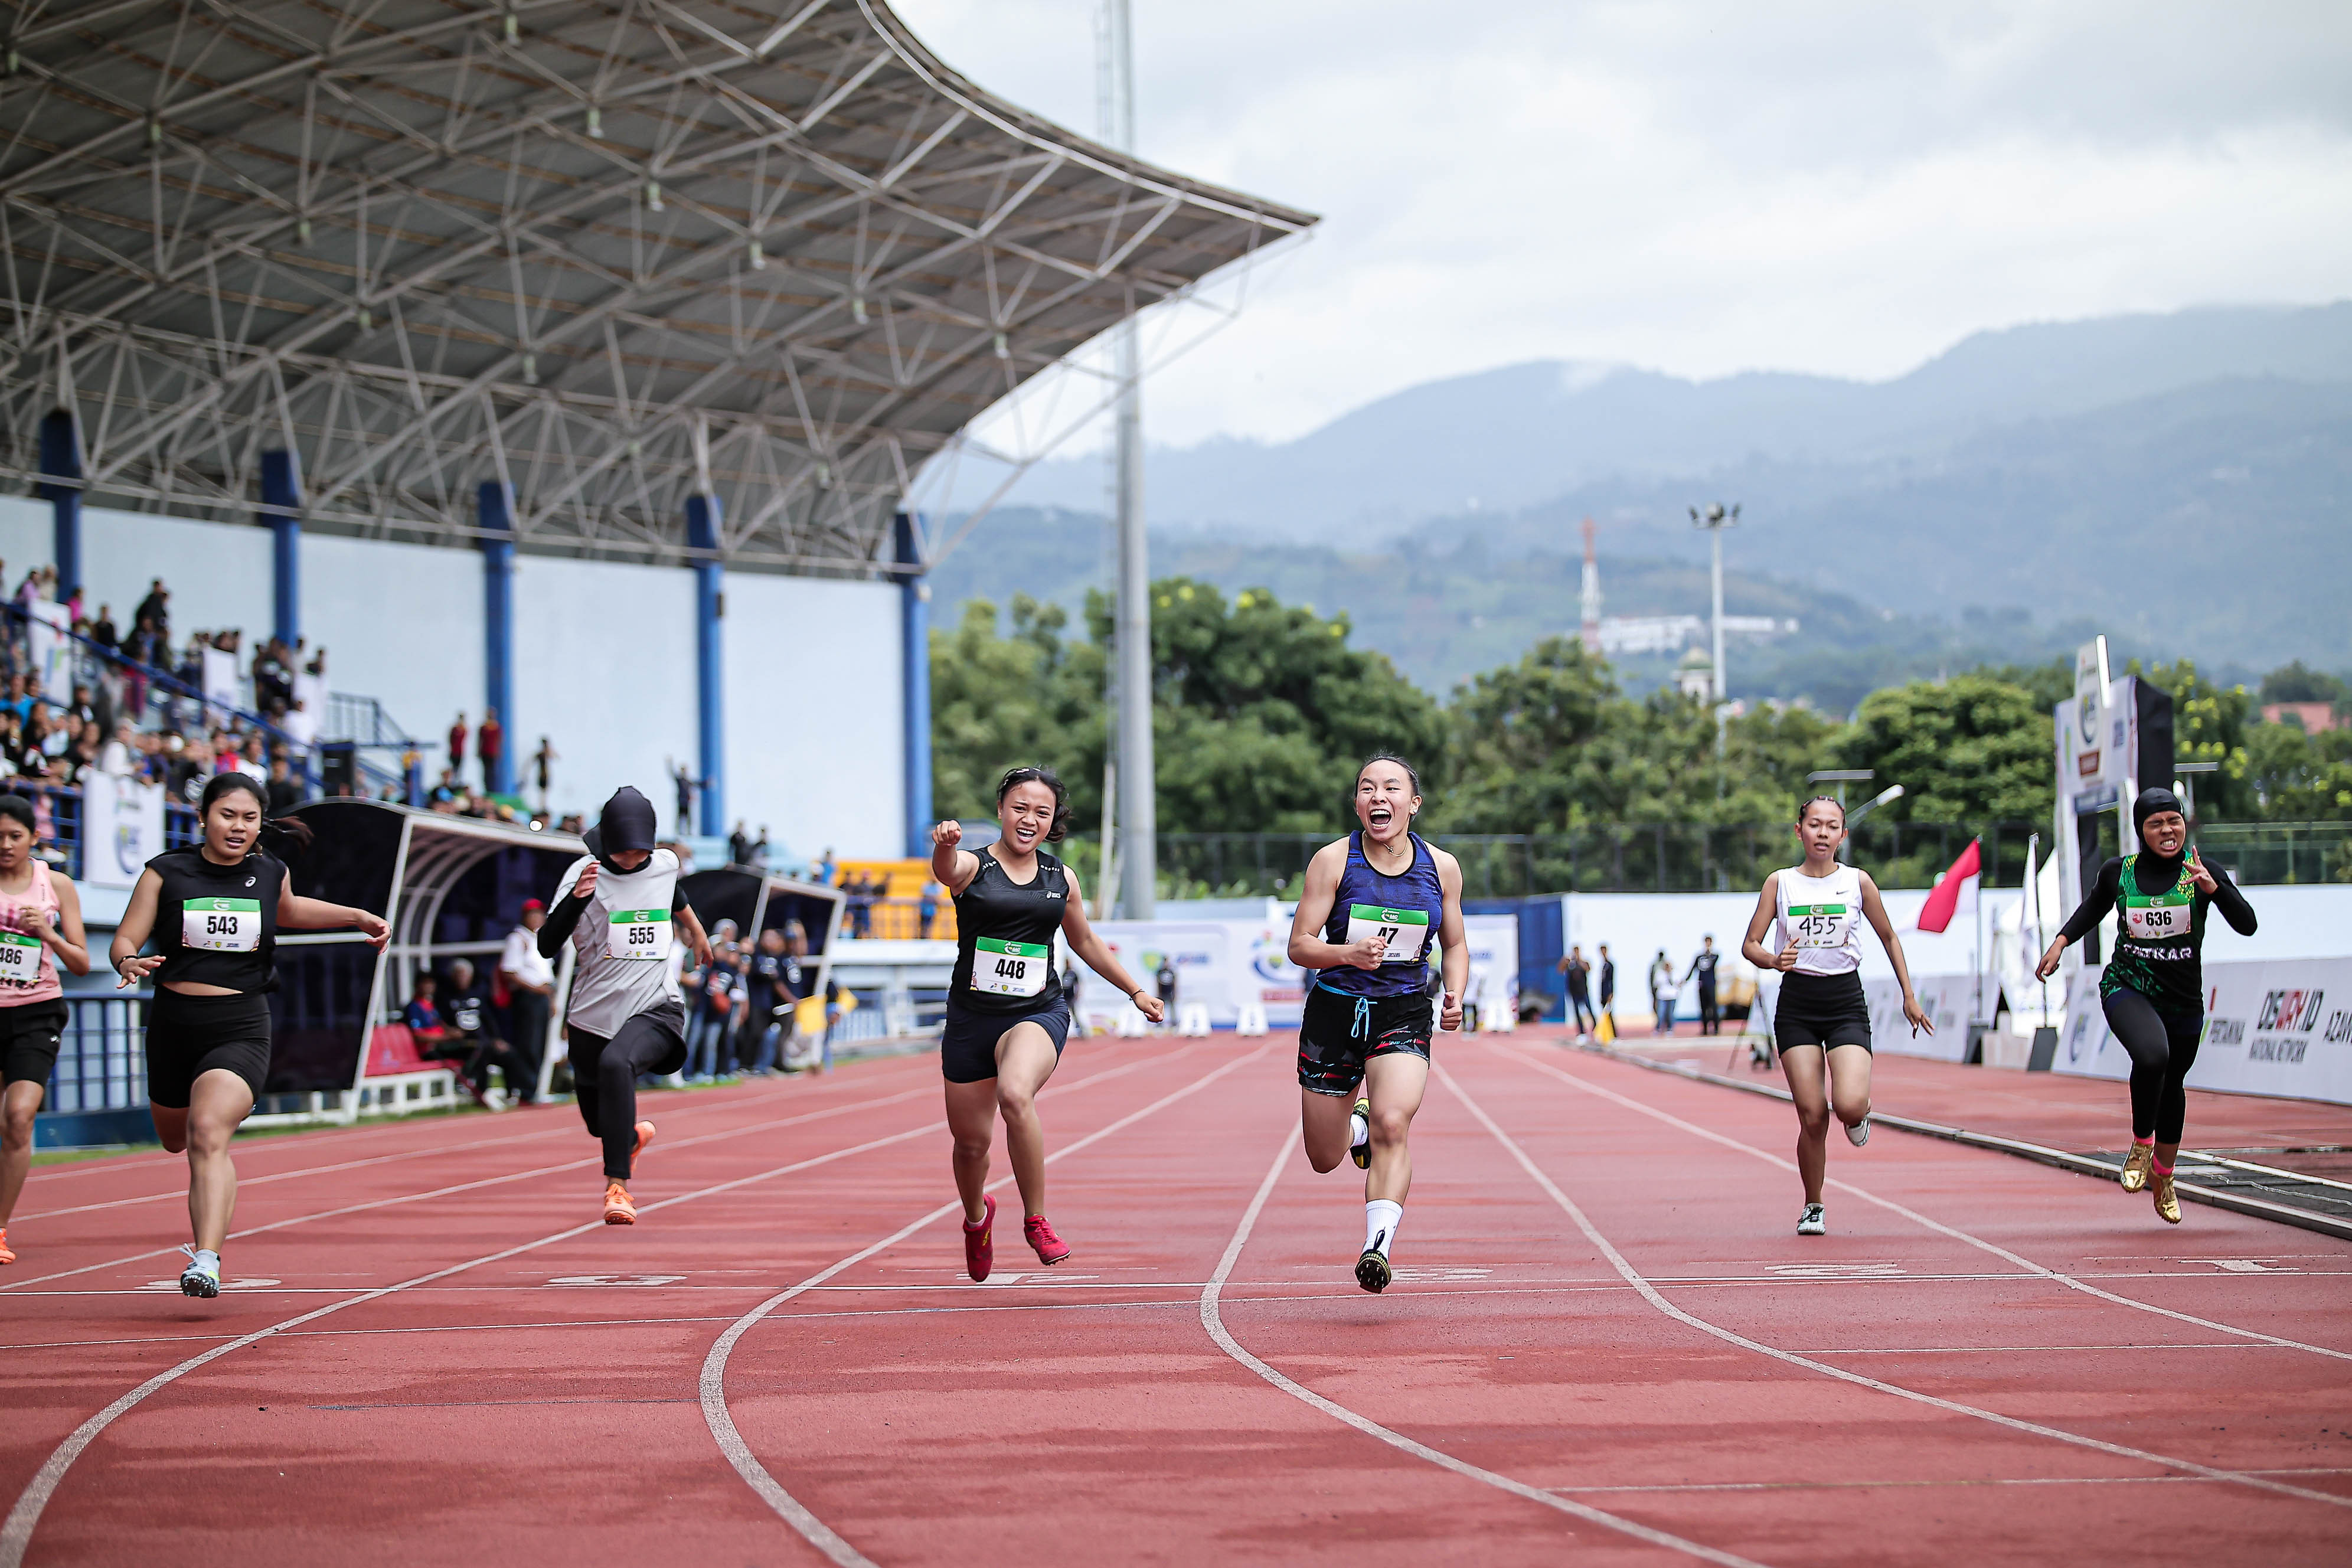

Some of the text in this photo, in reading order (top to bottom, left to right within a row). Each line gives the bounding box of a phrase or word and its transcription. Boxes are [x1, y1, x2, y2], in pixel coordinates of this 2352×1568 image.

[207, 916, 238, 935] 543
[1799, 916, 1843, 936] 455
[2145, 911, 2173, 926] 636
[629, 926, 655, 945] 555
[1377, 926, 1399, 945] 47
[995, 958, 1026, 979] 448
